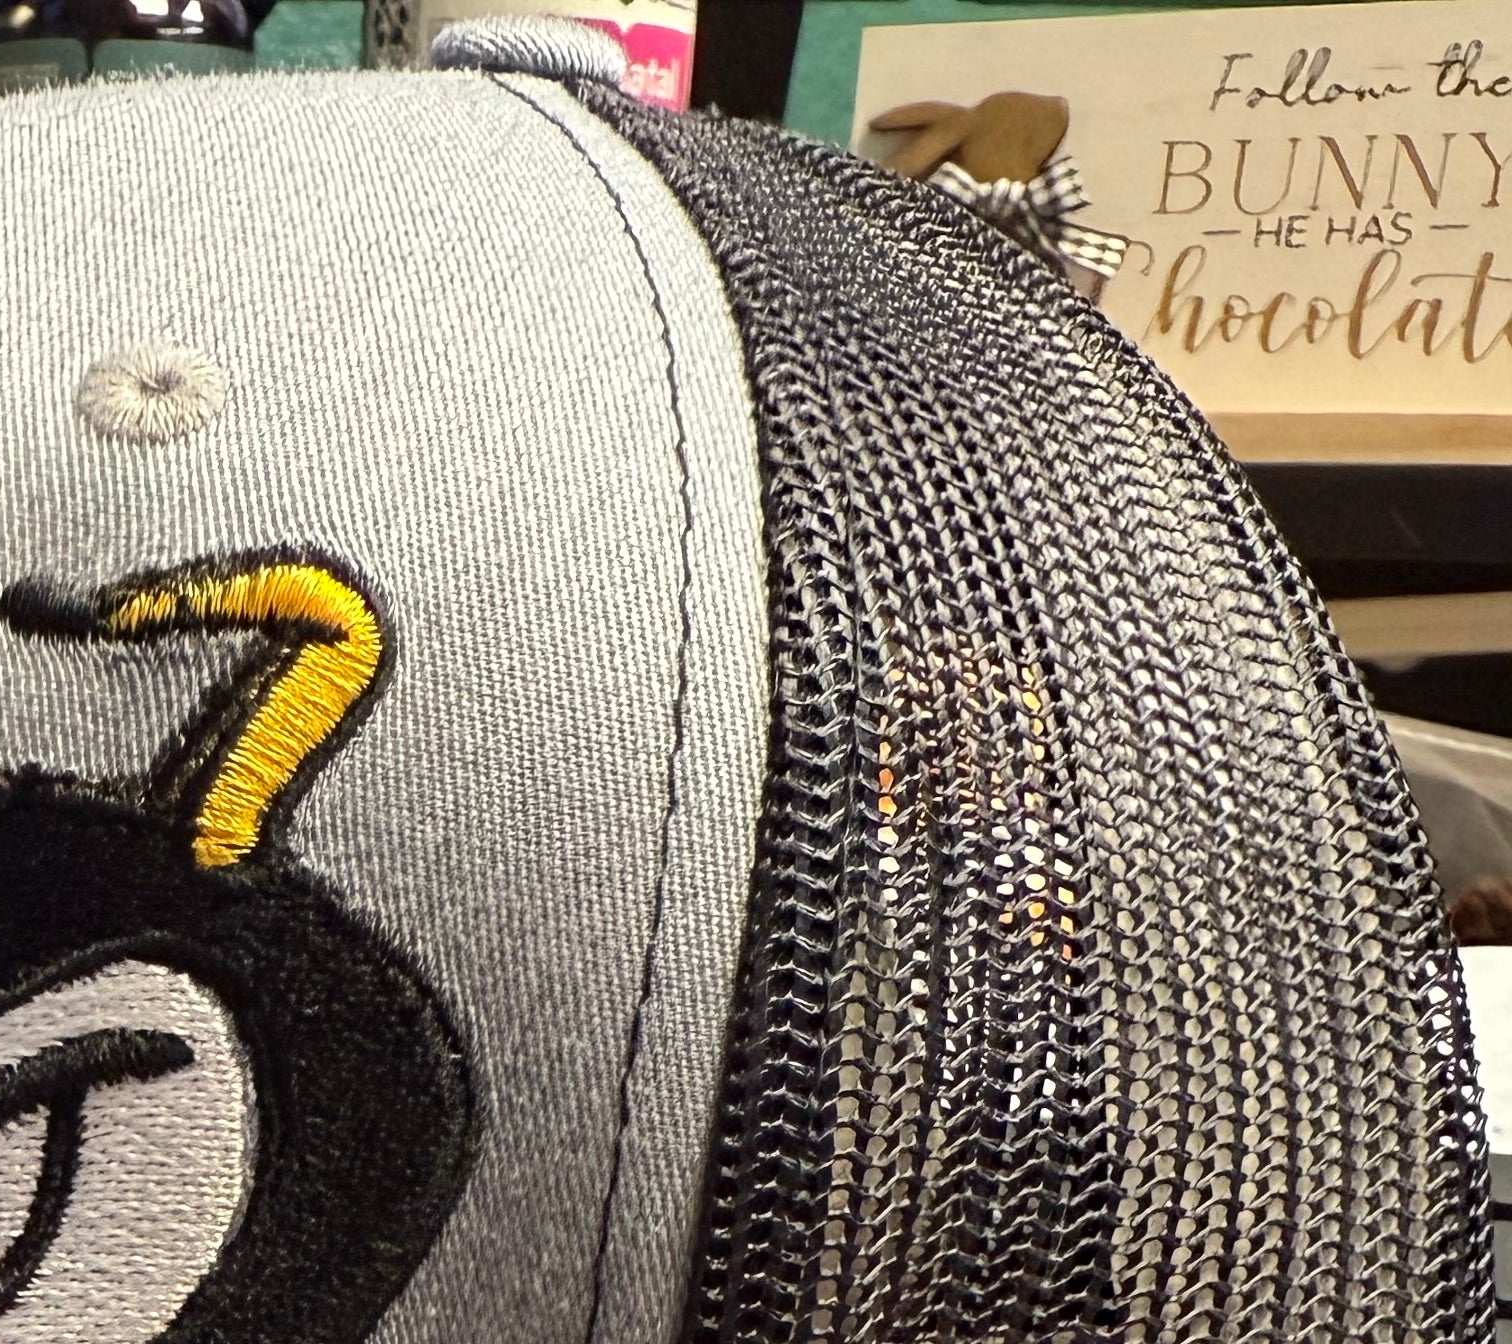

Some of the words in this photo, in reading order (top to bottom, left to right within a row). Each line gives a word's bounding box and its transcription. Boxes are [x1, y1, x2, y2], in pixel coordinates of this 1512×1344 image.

[1209, 46, 1411, 111] Follow
[1152, 132, 1512, 215] BUNNY
[1253, 215, 1310, 249] HE
[1325, 212, 1413, 248] HAS
